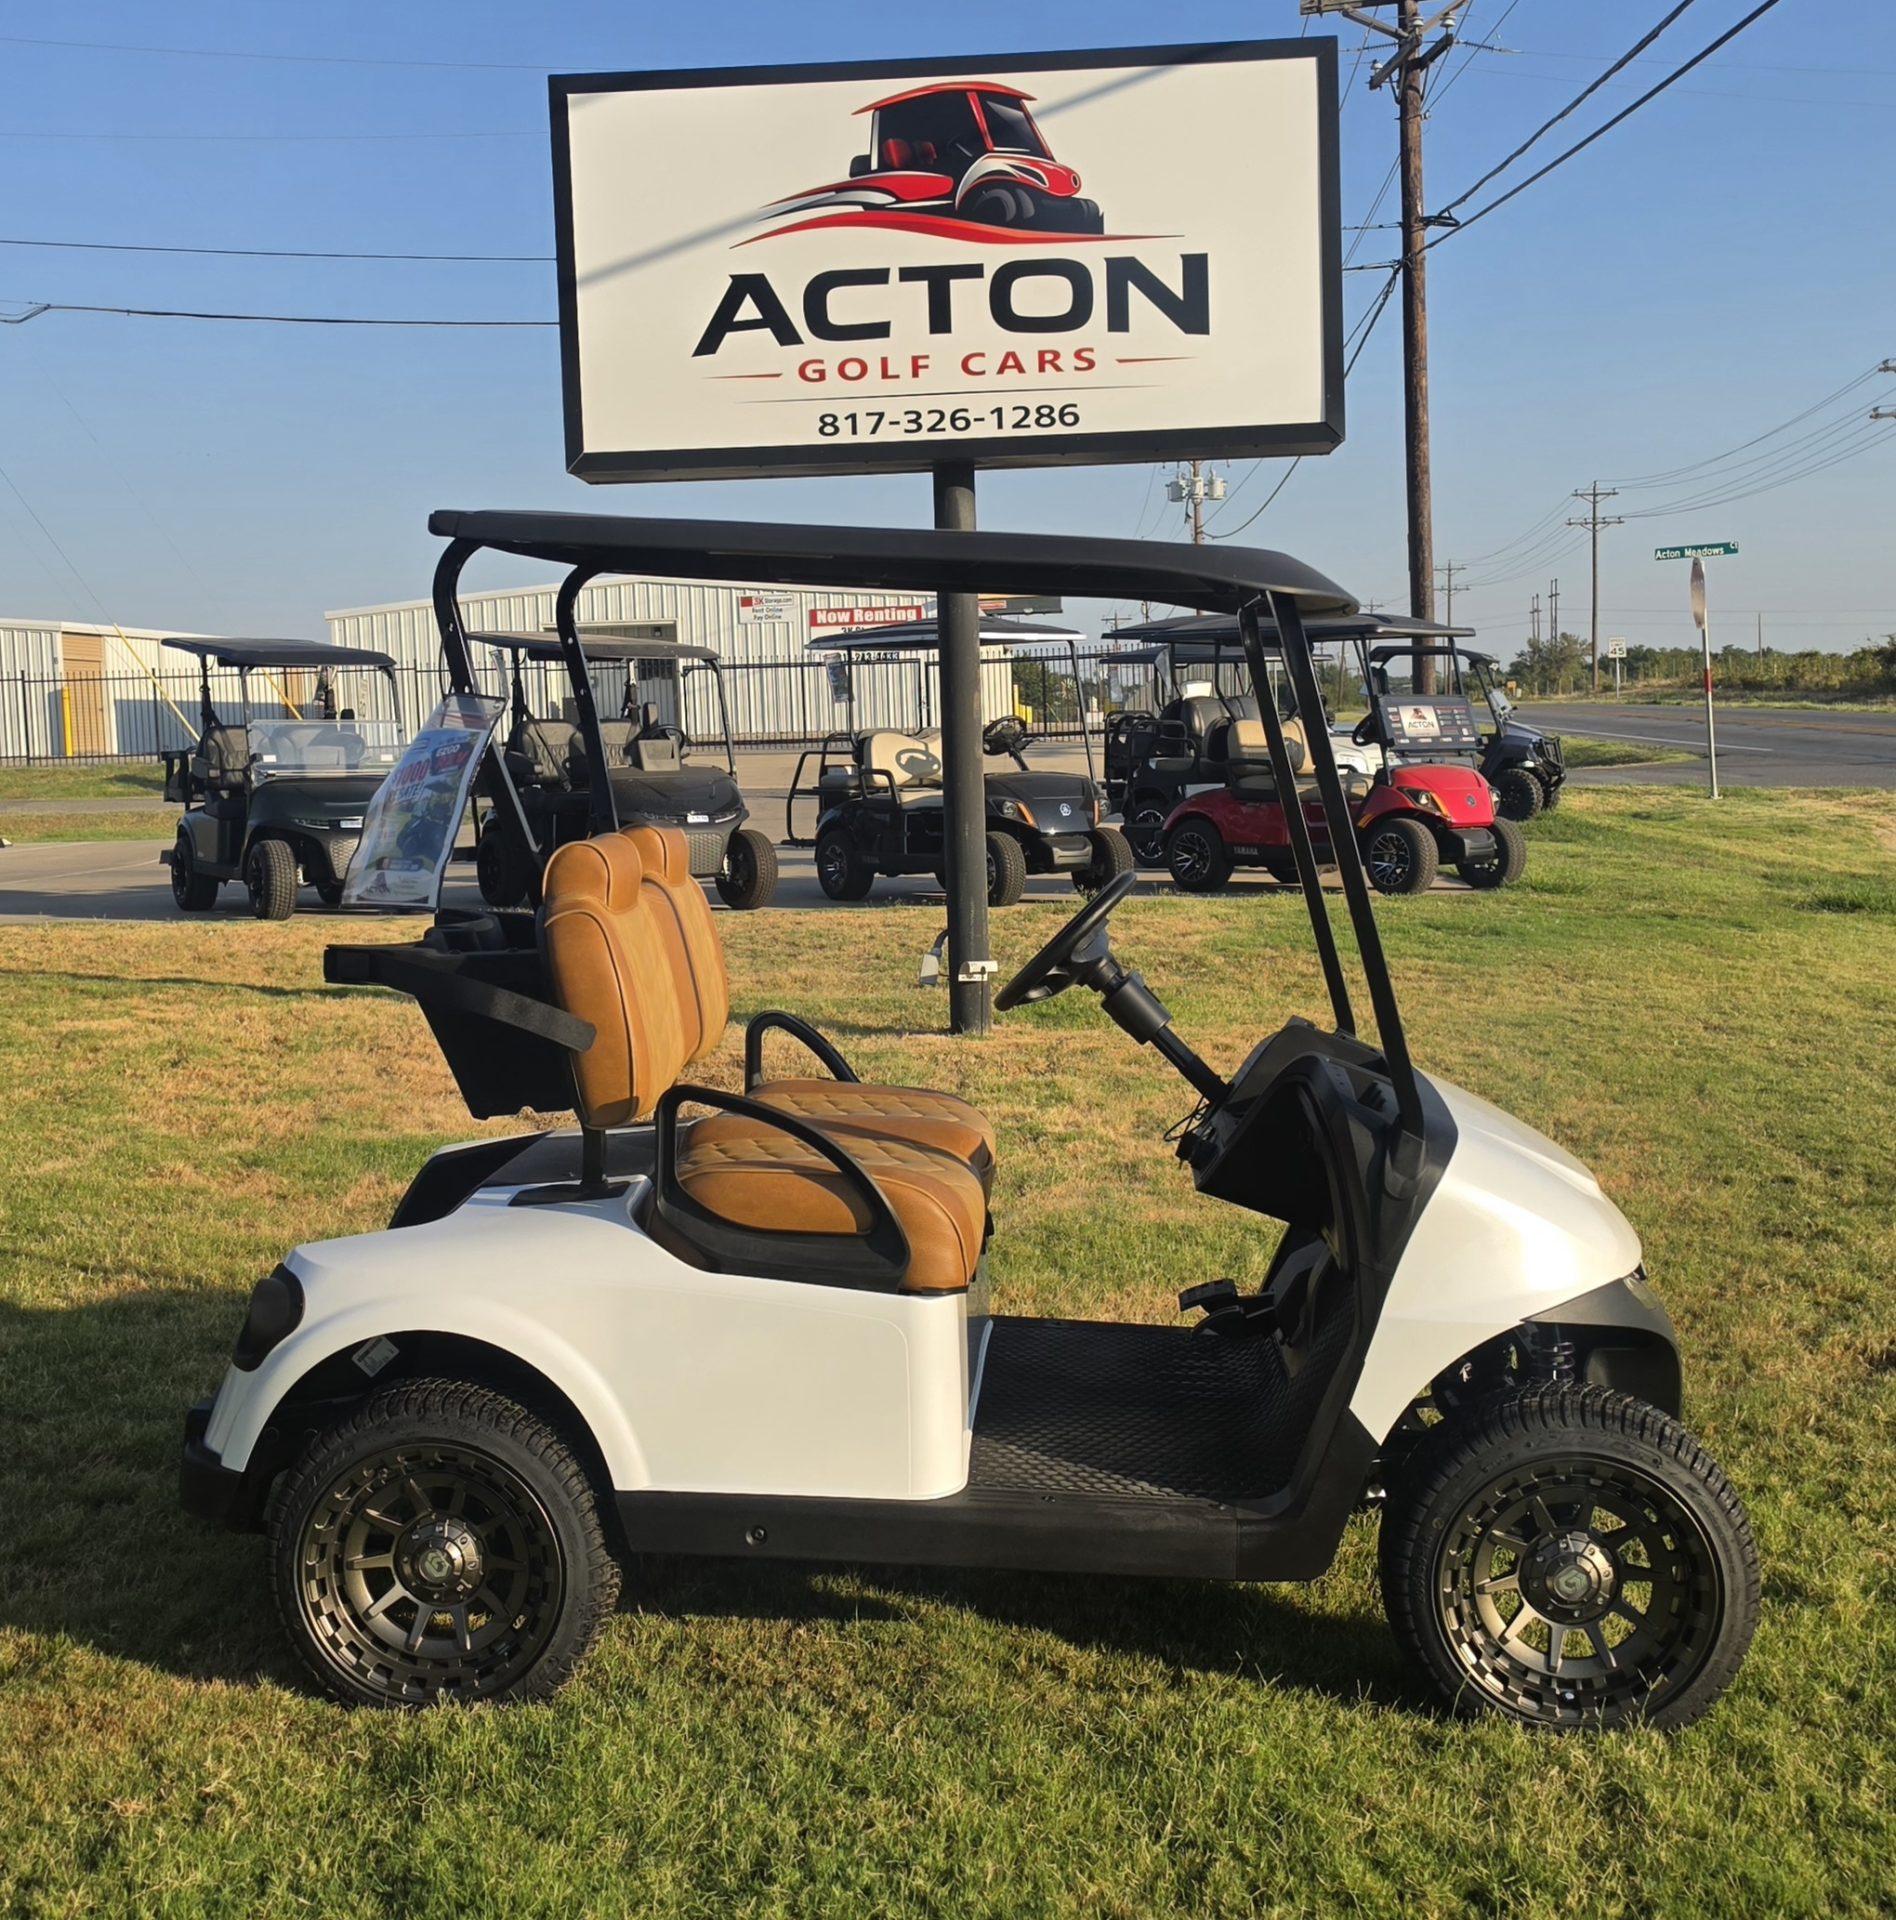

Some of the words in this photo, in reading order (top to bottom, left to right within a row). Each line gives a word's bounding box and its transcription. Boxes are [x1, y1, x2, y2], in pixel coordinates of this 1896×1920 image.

[692, 253, 1210, 357] ACTON
[799, 355, 930, 383] GOLF
[961, 348, 1096, 376] CARS
[819, 404, 1080, 436] 817-326-1286
[1656, 549, 1680, 559] Acton
[1684, 546, 1724, 558] Meadows
[816, 610, 851, 624] Now
[853, 608, 917, 622] Renting
[1610, 647, 1625, 655] 45
[1408, 721, 1435, 729] ACTON
